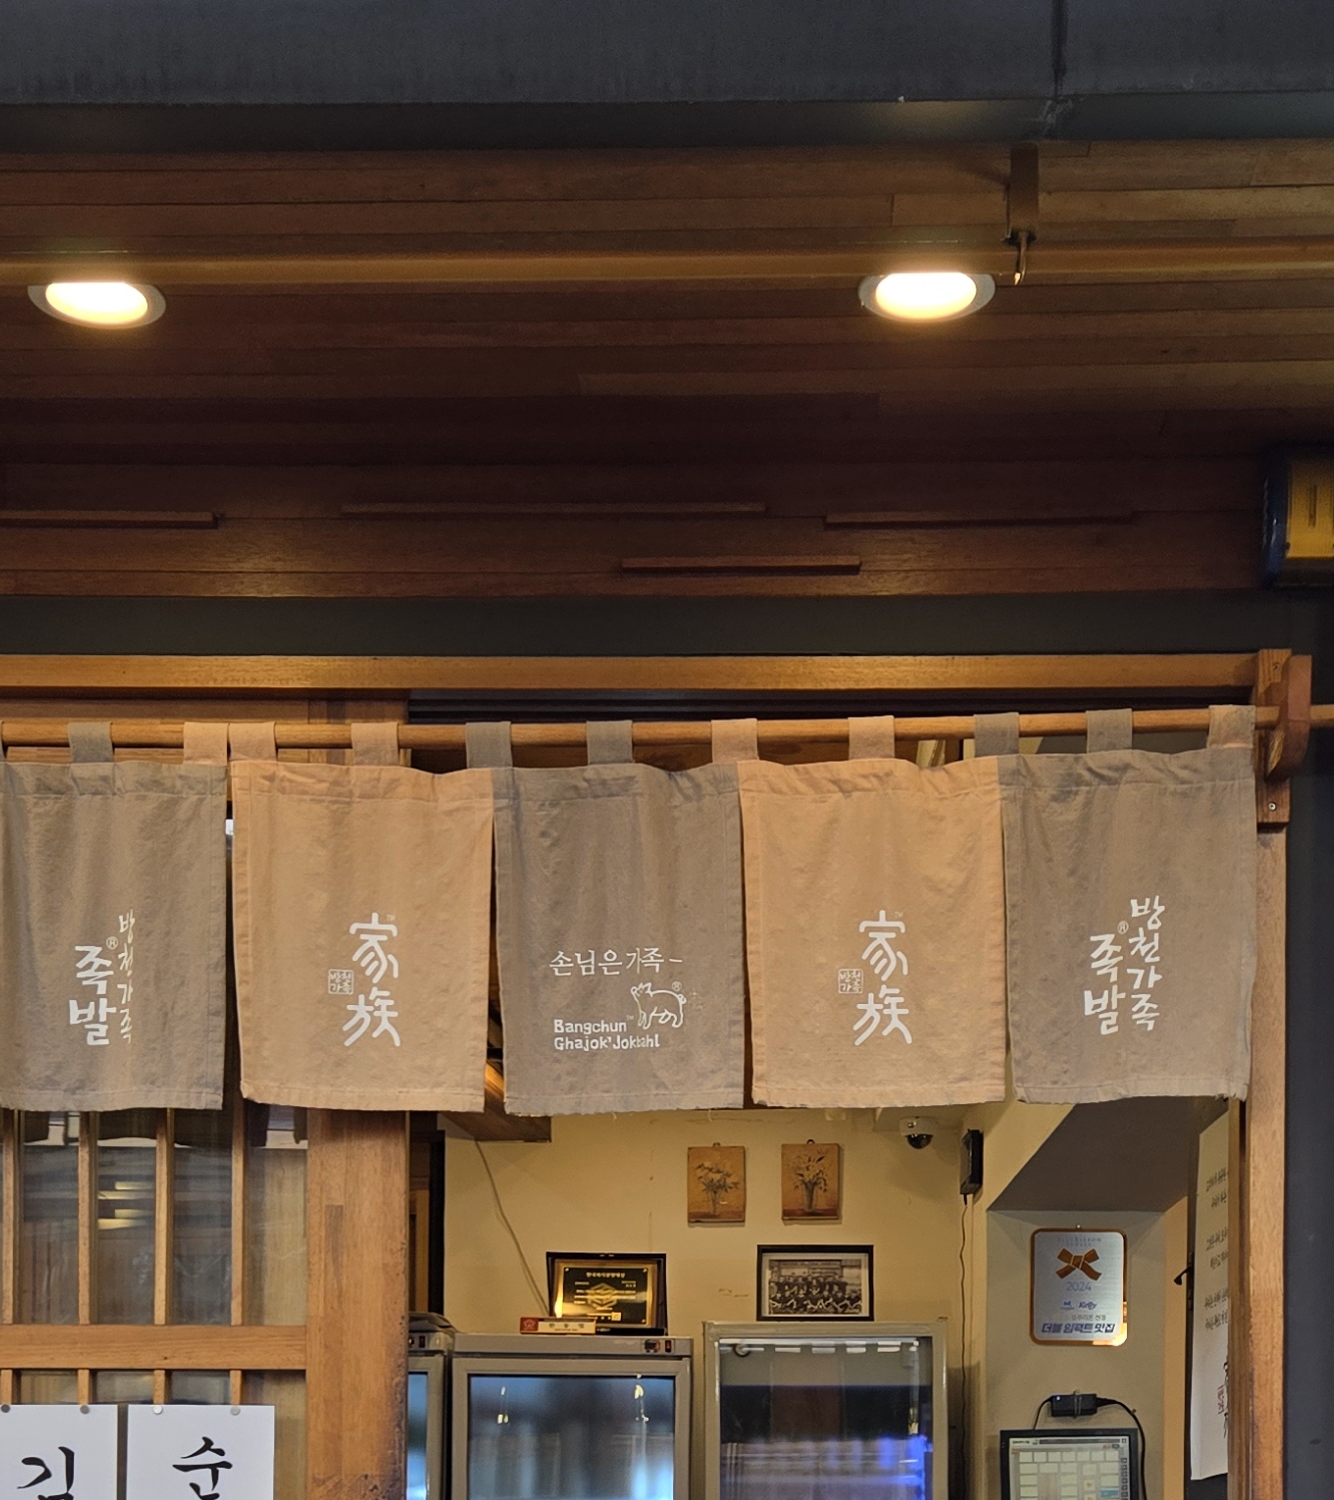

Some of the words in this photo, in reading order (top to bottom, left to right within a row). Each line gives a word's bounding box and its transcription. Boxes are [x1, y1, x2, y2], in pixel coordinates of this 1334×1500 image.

[549, 950, 623, 976] 손님은
[1084, 934, 1126, 1035] 족발
[1126, 895, 1165, 1031] 방천가족
[69, 945, 116, 1045] 족발
[553, 1019, 627, 1036] Bangchun
[1066, 1281, 1092, 1291] 2024
